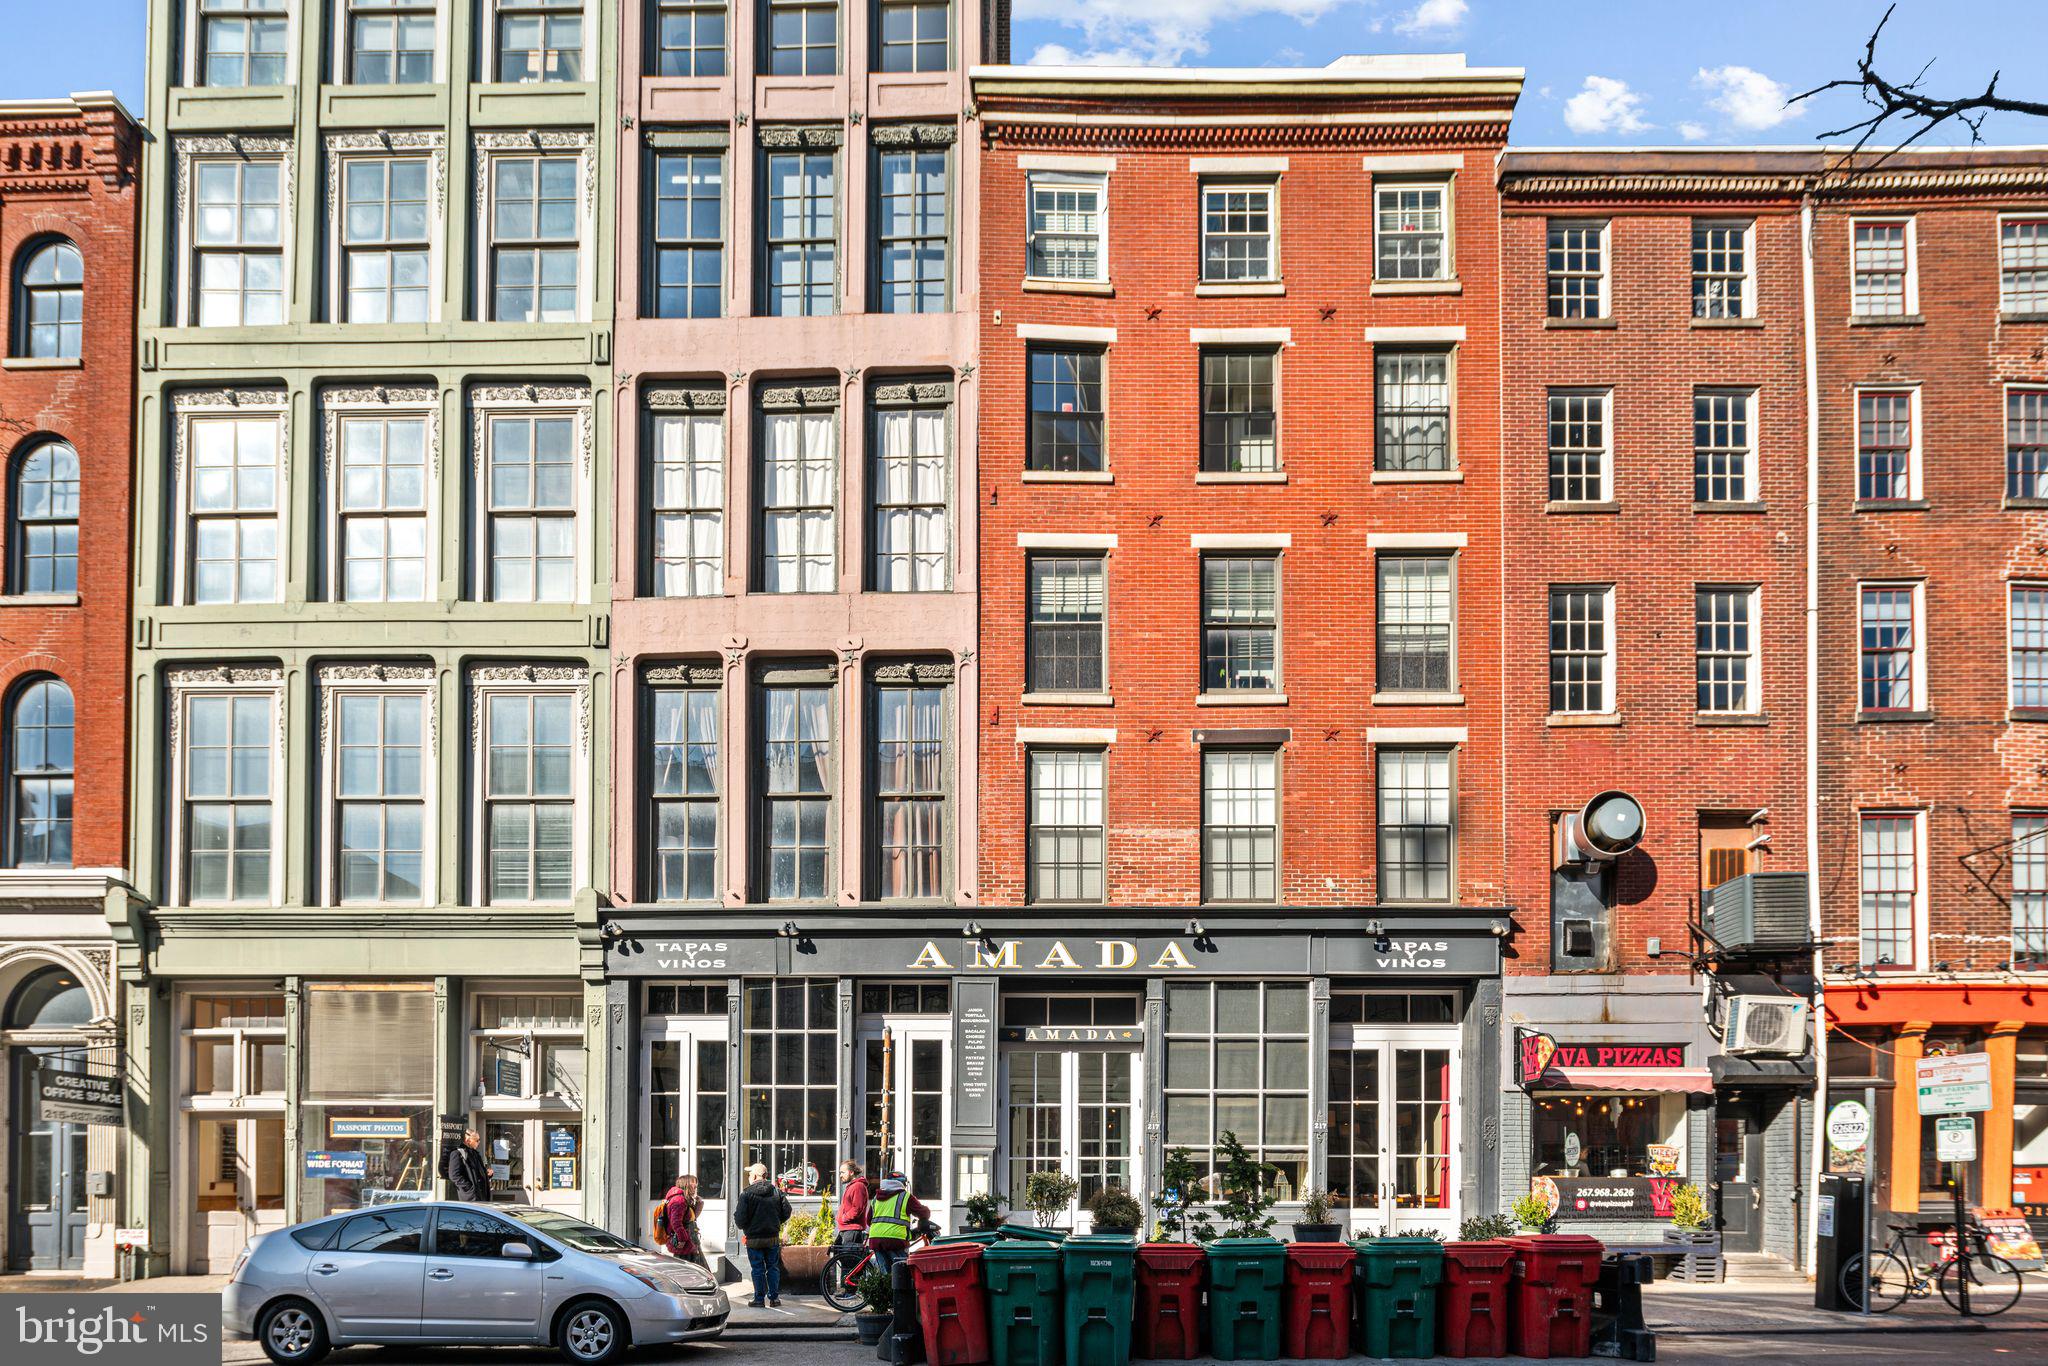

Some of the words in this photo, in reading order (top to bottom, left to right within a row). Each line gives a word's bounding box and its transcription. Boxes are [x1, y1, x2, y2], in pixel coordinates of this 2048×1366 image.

[655, 942, 728, 952] TAPAS
[1374, 941, 1448, 952] TAPAS
[685, 951, 698, 960] Y
[906, 940, 1196, 969] AMADA
[1404, 950, 1418, 959] Y
[1027, 1029, 1117, 1040] AMADA
[1550, 1047, 1591, 1067] IVA
[1598, 1047, 1683, 1067] PIZZAS
[55, 1075, 110, 1092] CREATIVE
[42, 1086, 84, 1100] OFFICE
[86, 1091, 122, 1104] SPACE
[229, 1098, 245, 1107] 221
[337, 1124, 371, 1132] PASSPORT
[374, 1124, 404, 1132] PHOTOS
[441, 1122, 463, 1130] PASSPORT
[442, 1131, 462, 1140] PHOTOS
[307, 1160, 331, 1168] WIDE
[331, 1160, 364, 1168] FORMAT
[341, 1168, 365, 1176] Printing
[1576, 1188, 1634, 1197] 267.968.2626
